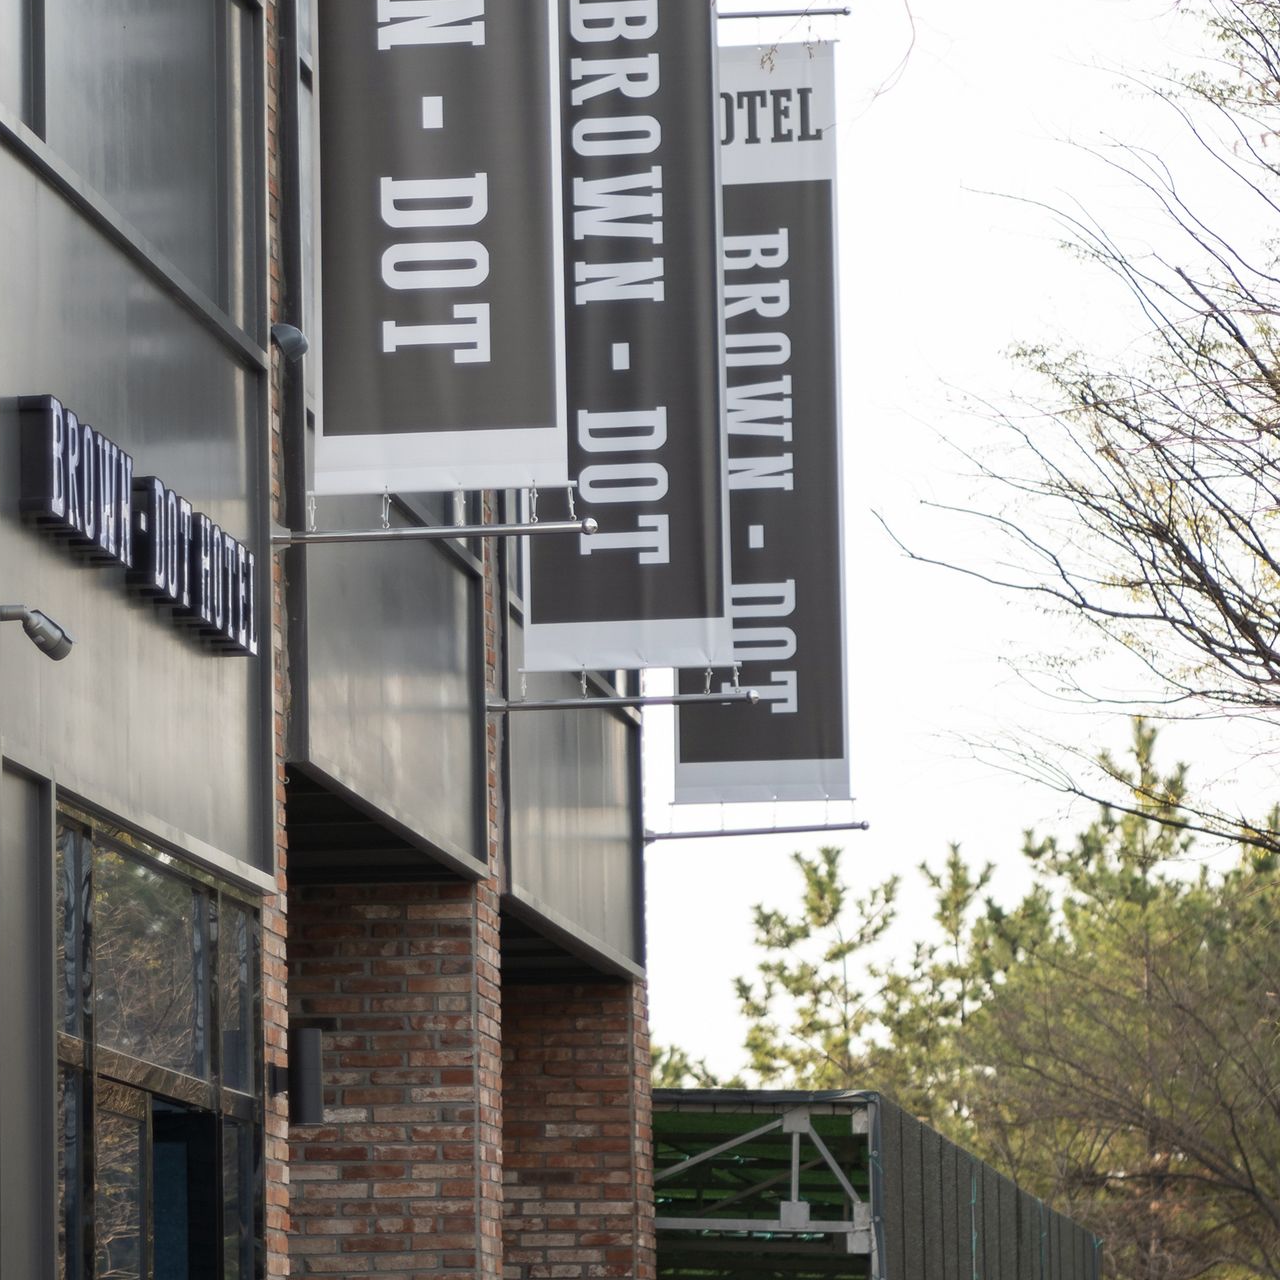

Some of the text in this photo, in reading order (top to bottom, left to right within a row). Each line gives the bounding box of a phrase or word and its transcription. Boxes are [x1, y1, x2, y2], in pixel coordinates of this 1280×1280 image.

[720, 87, 824, 146] OTEL
[379, 172, 492, 365] DOT
[722, 227, 795, 492] BROWN
[577, 405, 671, 566] DOT
[200, 512, 259, 658] HOTEL
[721, 578, 799, 715] DOT
